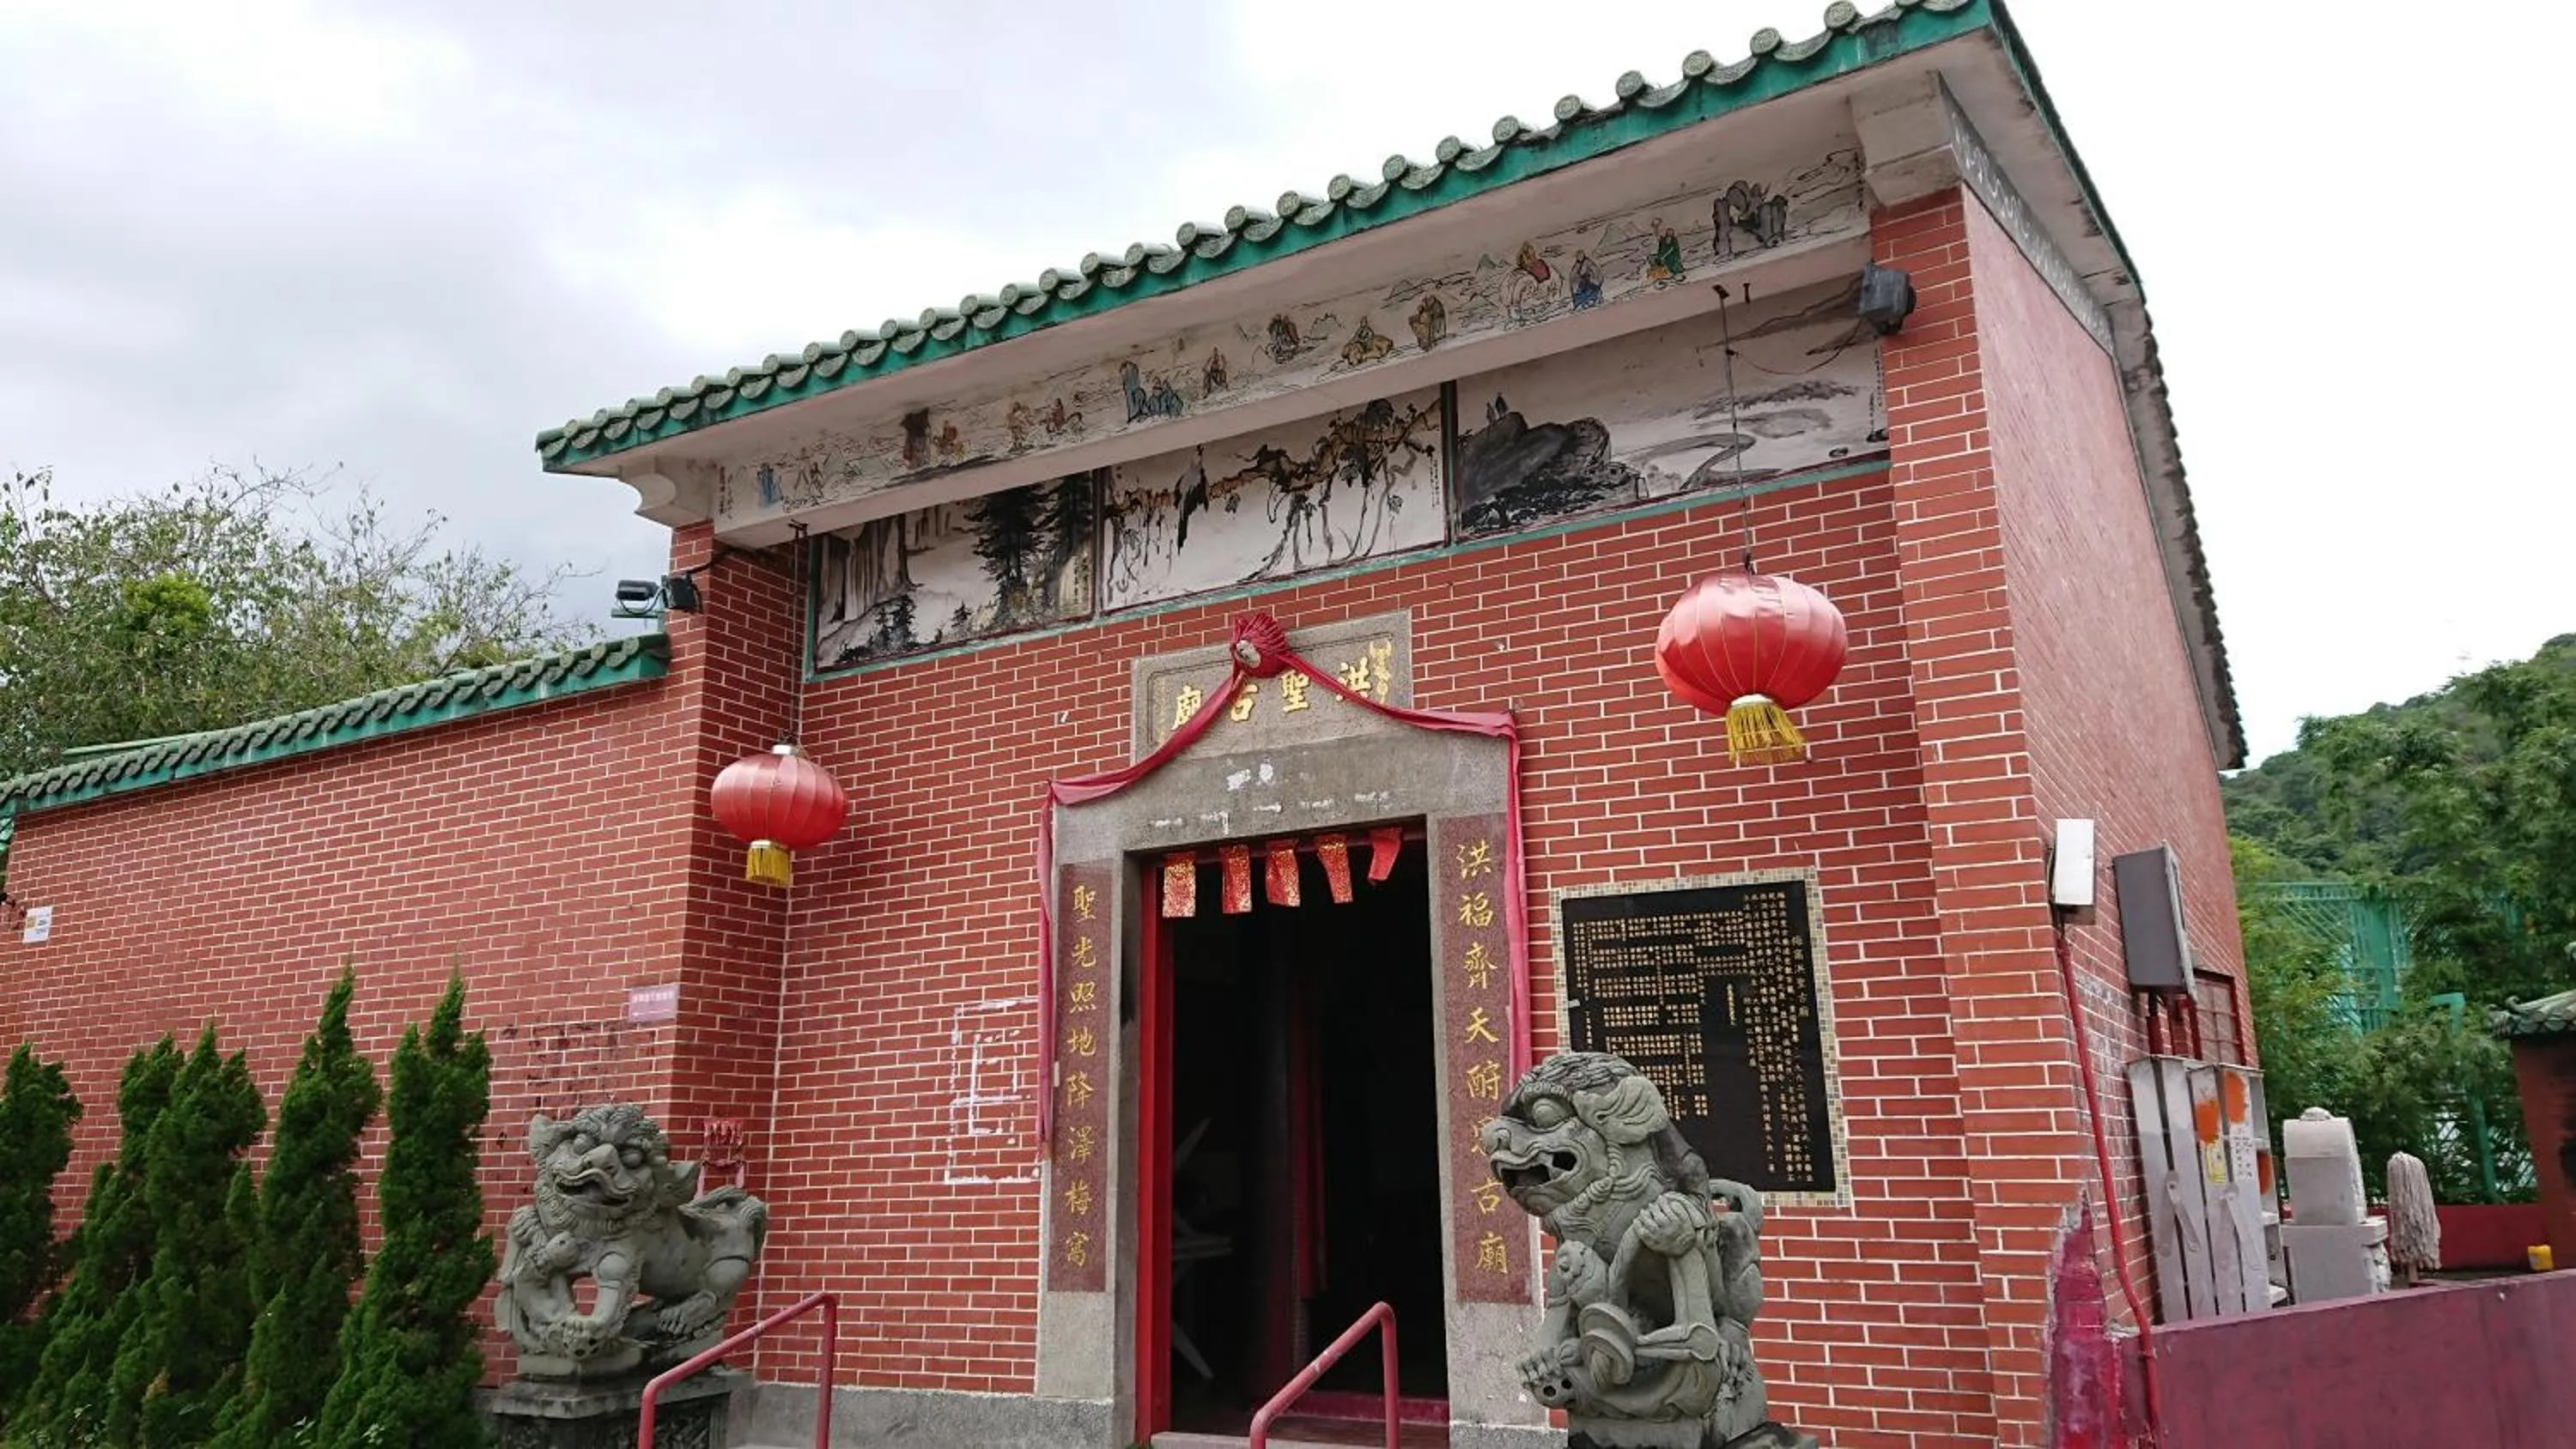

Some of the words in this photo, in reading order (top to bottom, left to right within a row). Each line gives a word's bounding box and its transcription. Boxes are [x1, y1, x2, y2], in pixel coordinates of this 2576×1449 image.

[1170, 656, 1372, 730] 洪聖古廟
[1065, 884, 1098, 1269] 聖光照地降澤梅窩
